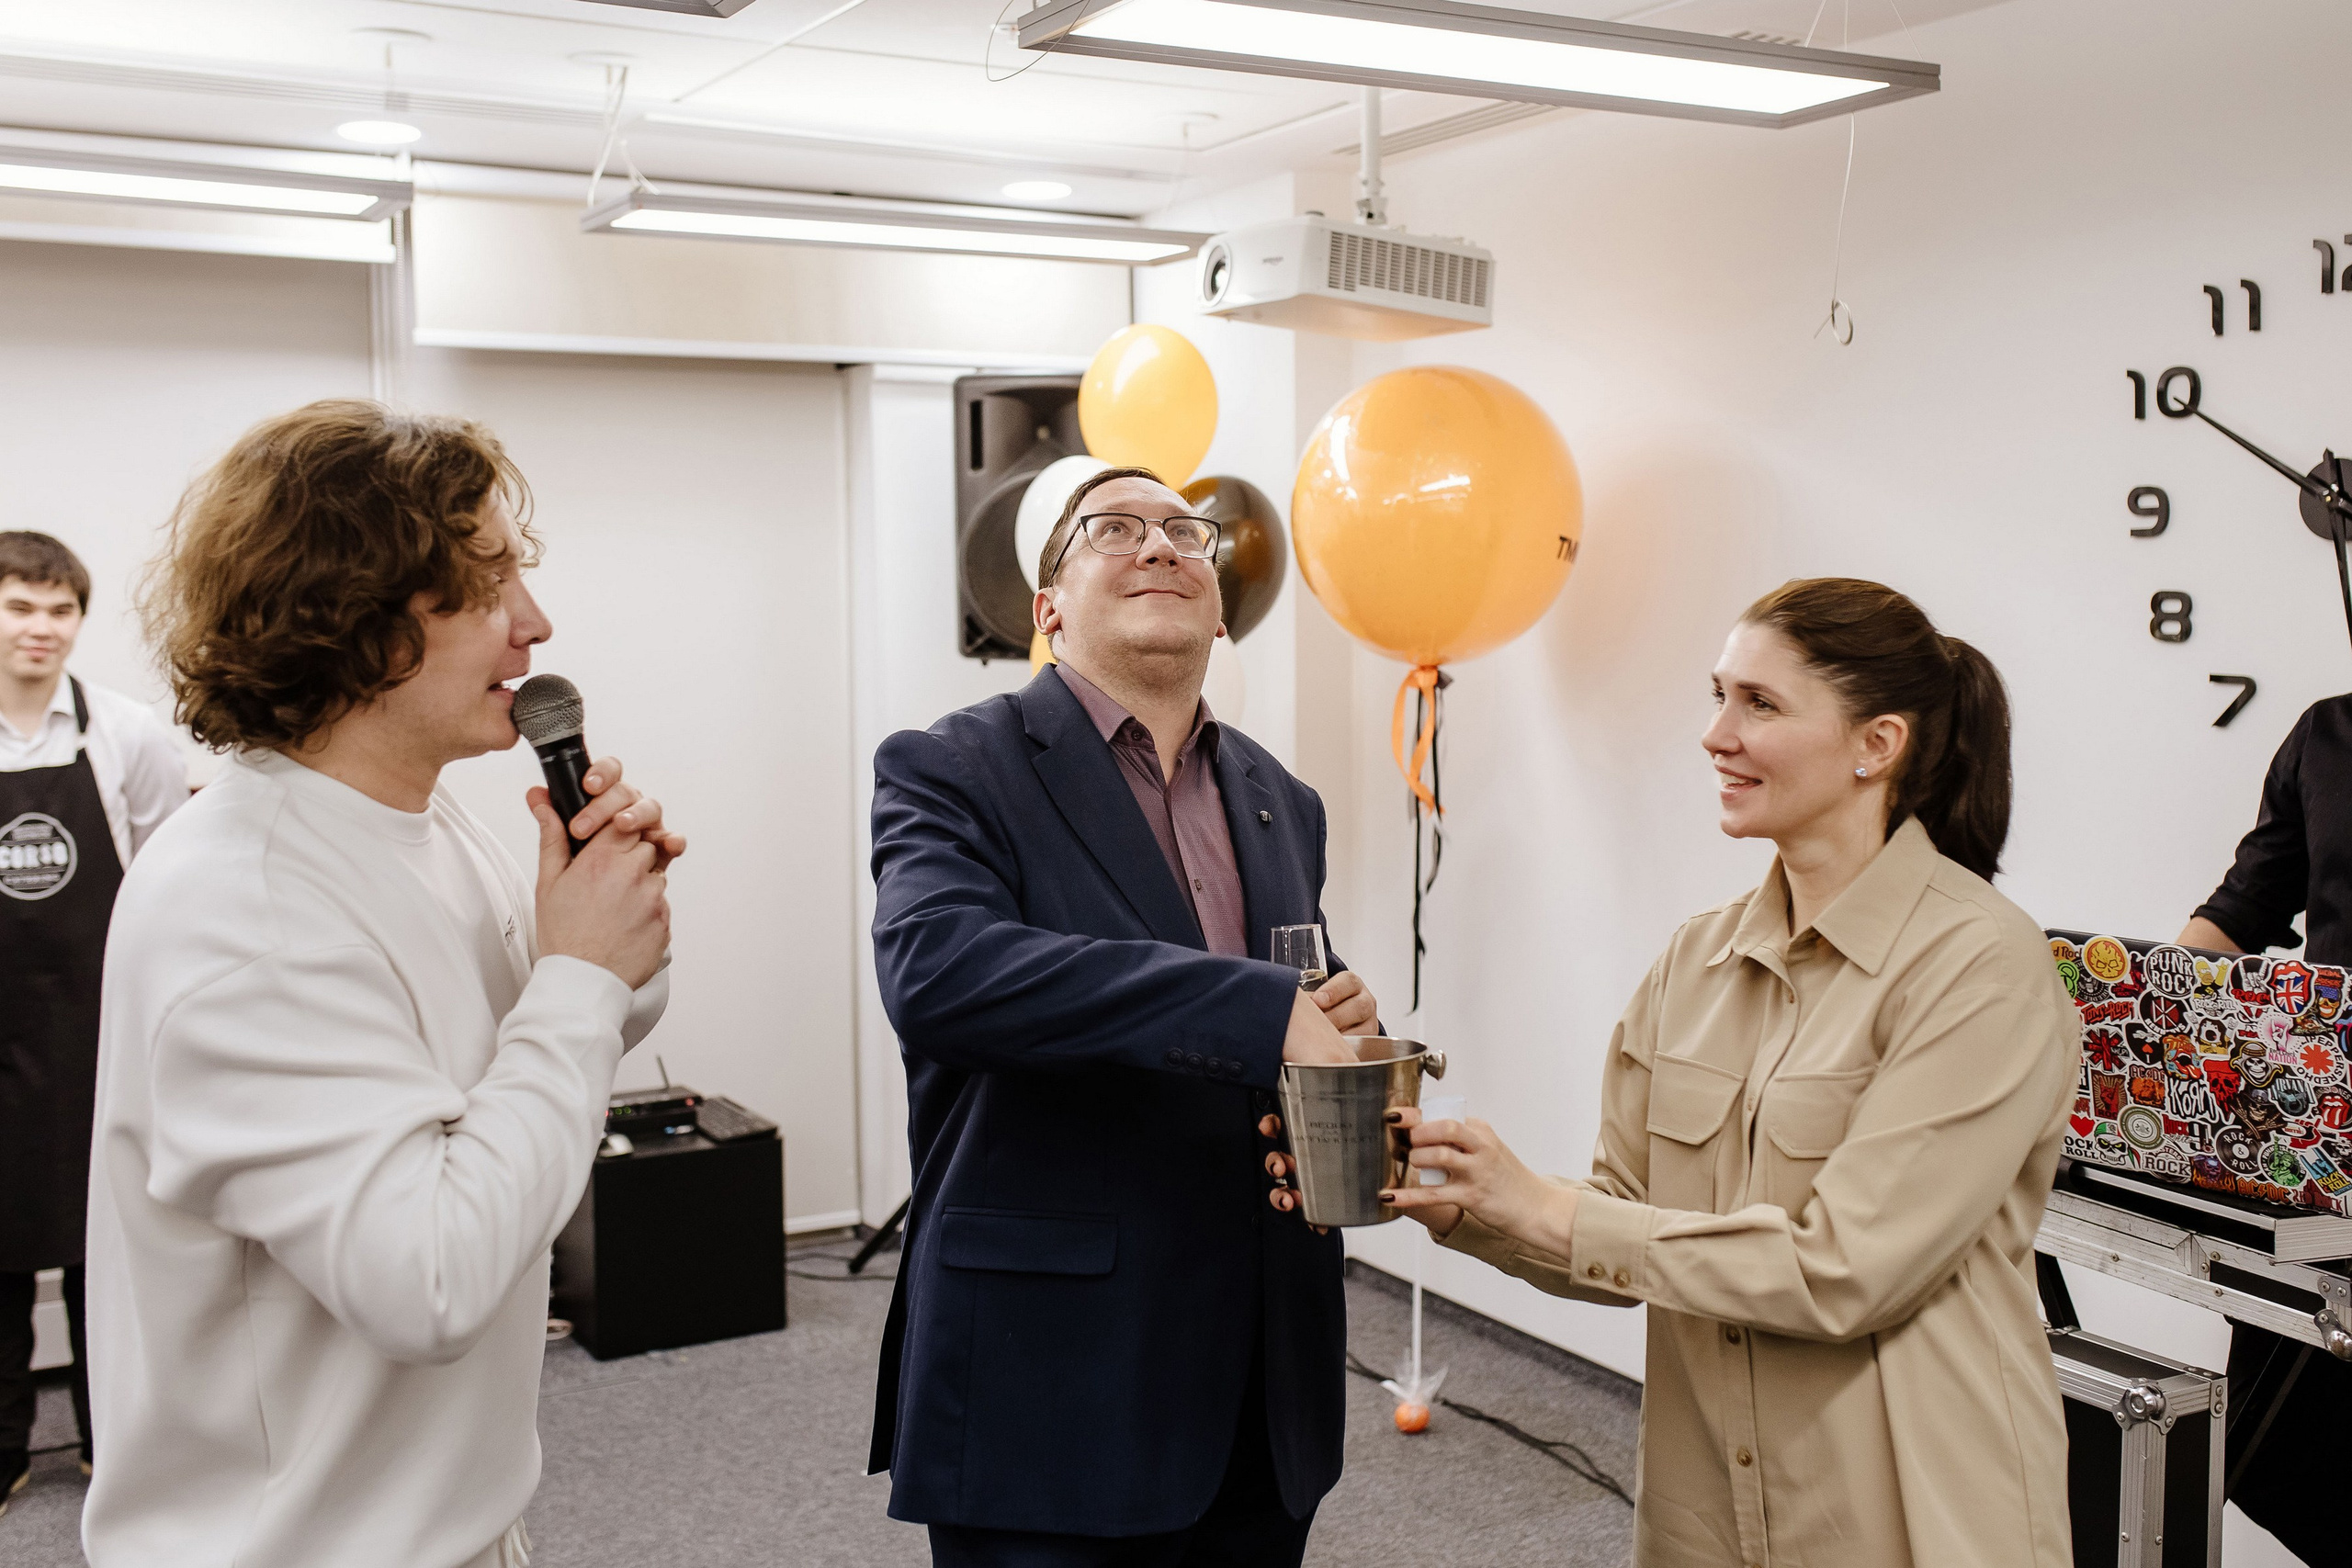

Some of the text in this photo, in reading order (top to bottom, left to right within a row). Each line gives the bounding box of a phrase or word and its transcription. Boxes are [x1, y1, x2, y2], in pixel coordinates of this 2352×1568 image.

[2312, 234, 2352, 294] 1
[2203, 278, 2261, 336] 11
[2126, 365, 2202, 421] 10
[2127, 486, 2170, 537] 9
[2150, 591, 2193, 643] 8
[2209, 674, 2257, 728] 7
[2150, 952, 2193, 976] PUNK
[2152, 970, 2193, 994] ROCK
[2268, 1052, 2298, 1065] NATION
[2064, 1135, 2094, 1150] OCK
[2223, 1132, 2253, 1145] ROCK
[2144, 1156, 2191, 1176] ROCK
[2231, 1158, 2258, 1170] ROLL
[2316, 1171, 2344, 1188] ROCK
[2327, 1178, 2351, 1192] ROLL
